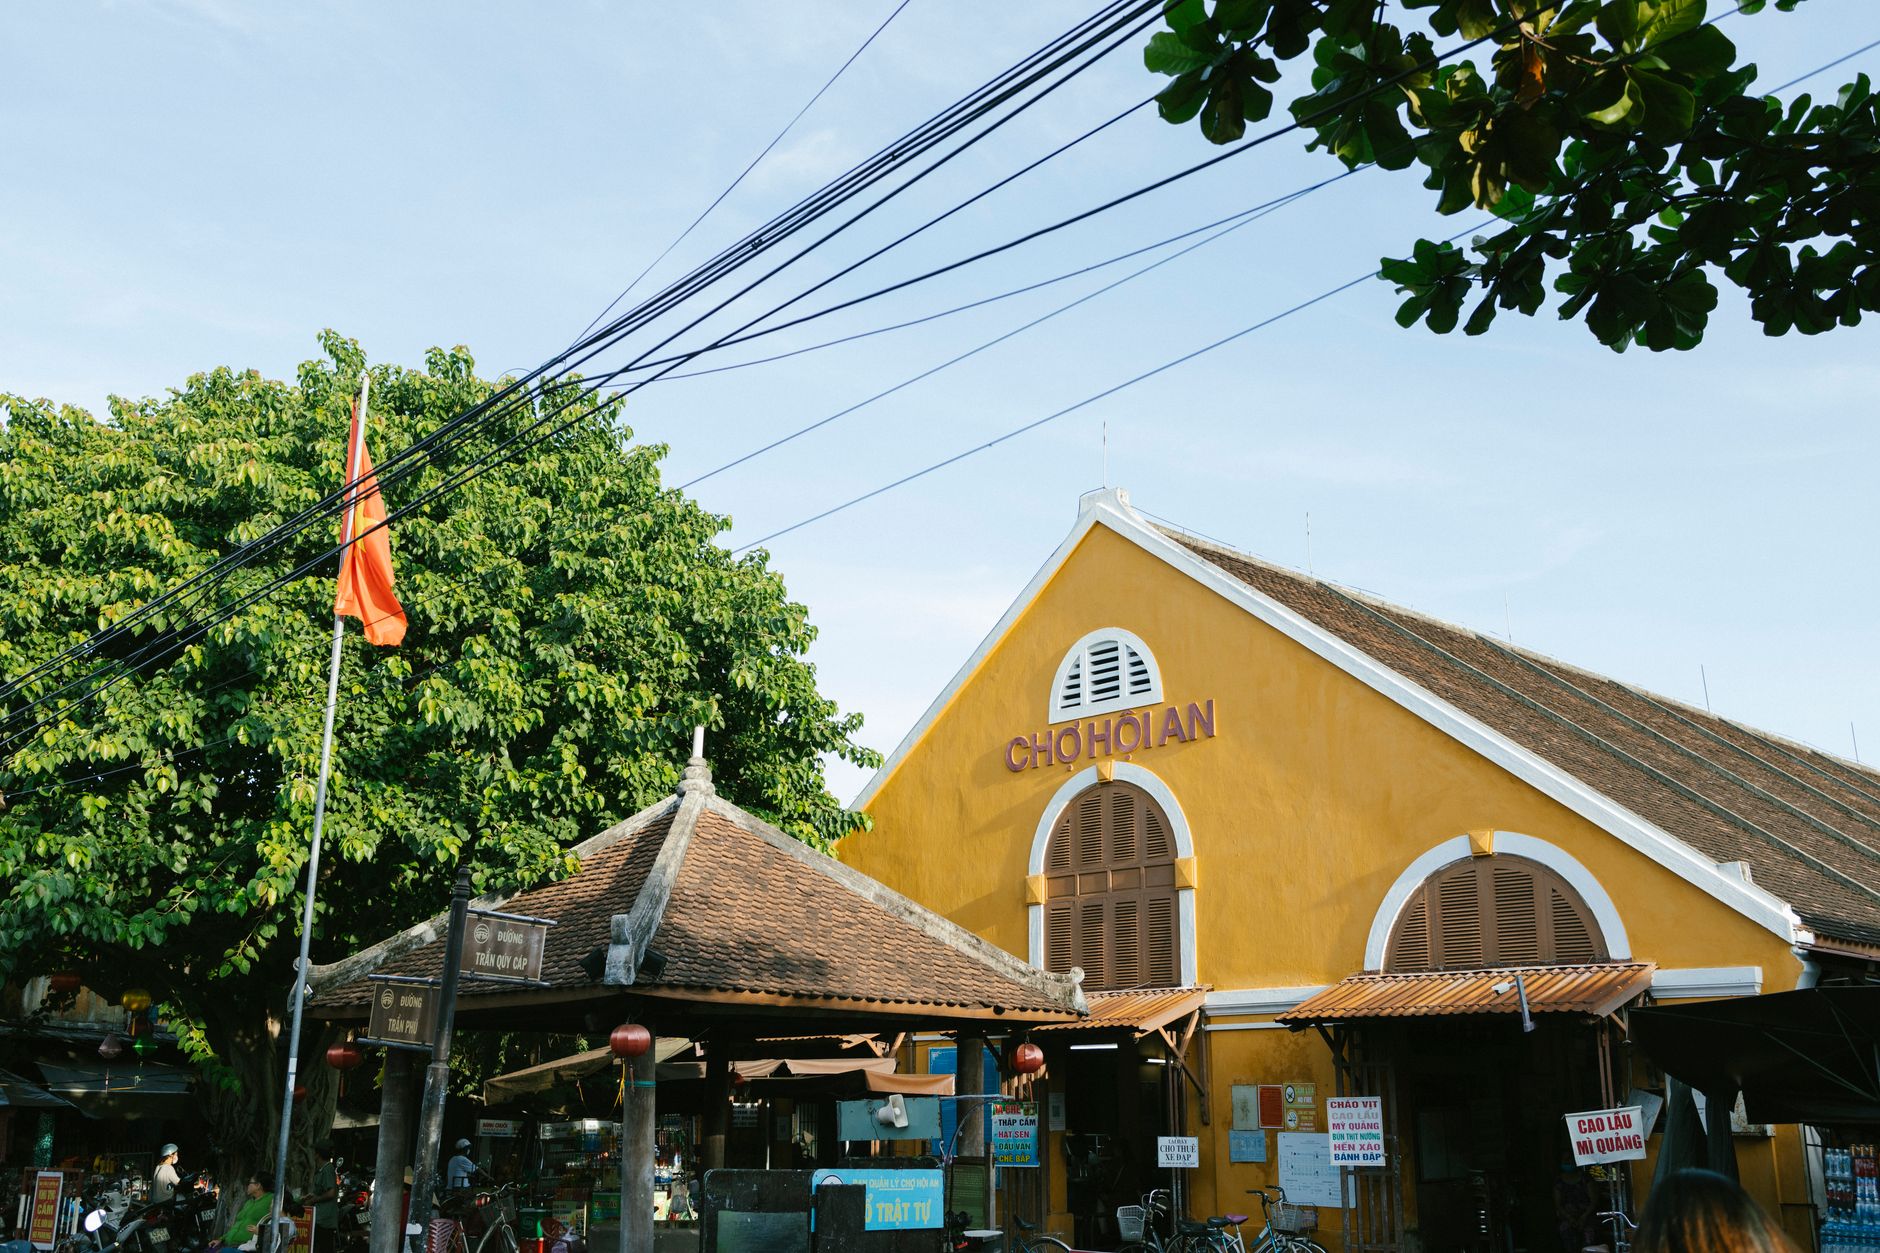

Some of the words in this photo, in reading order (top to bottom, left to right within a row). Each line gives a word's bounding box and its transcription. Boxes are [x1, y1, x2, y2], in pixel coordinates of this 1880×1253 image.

[1005, 720, 1082, 772] CHỢ
[1088, 710, 1153, 761] HỘI
[1159, 699, 1217, 747] AN
[497, 929, 523, 944] ĐƯỜNG
[475, 948, 496, 967] TRẦN
[400, 992, 423, 1008] ĐƯỜNG
[388, 1013, 405, 1033] TRẦN
[405, 1018, 419, 1035] PHÚ
[1361, 1100, 1378, 1110] VỊT
[998, 1117, 1017, 1128] THẬP
[1332, 1112, 1354, 1120] CAO
[1577, 1117, 1605, 1134] CAO
[1014, 1131, 1030, 1139] SEN
[1176, 1143, 1197, 1153] THUÊ
[1576, 1136, 1595, 1156] MÌ
[1596, 1132, 1643, 1155] QUẢNG
[1165, 1153, 1175, 1161] XE
[1334, 1151, 1360, 1161] BÁNH
[890, 1177, 900, 1188] LÝ
[929, 1179, 939, 1188] AN
[876, 1197, 910, 1226] TRẬT
[913, 1198, 931, 1225] TỰ
